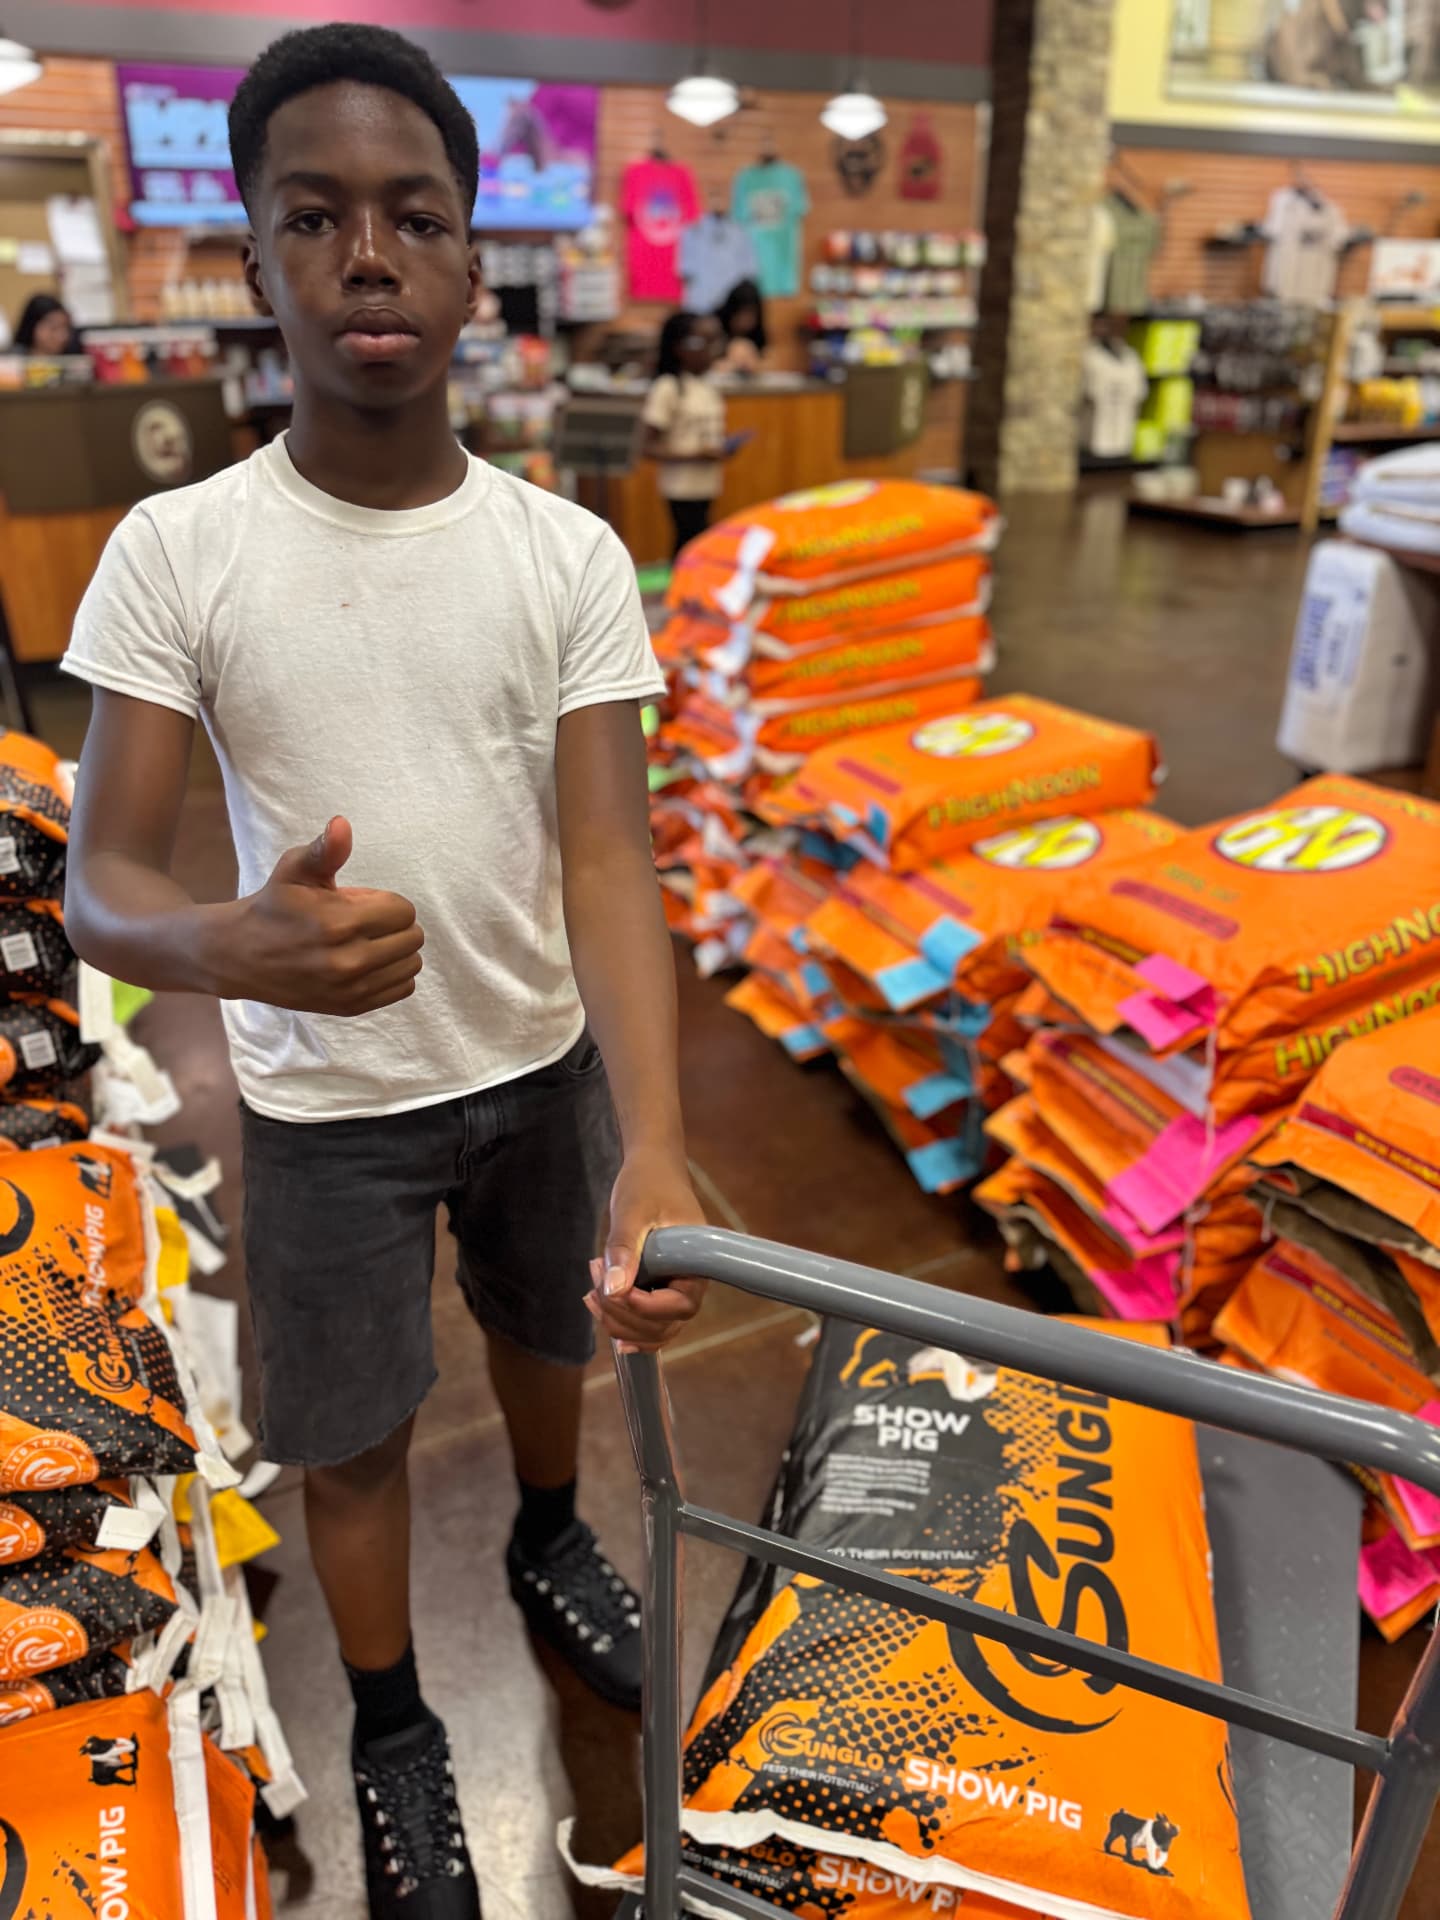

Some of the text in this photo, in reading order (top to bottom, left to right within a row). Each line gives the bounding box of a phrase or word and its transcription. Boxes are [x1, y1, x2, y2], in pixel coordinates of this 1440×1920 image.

[85, 1204, 106, 1241] PIG
[853, 1403, 971, 1436] SHOW
[877, 1424, 939, 1452] PIG
[848, 1547, 890, 1560] THEIR
[769, 1725, 885, 1772] SUNGLO
[763, 1763, 789, 1774] FEED
[789, 1766, 817, 1781] THEIR
[905, 1757, 1082, 1831] SHOW PIG
[98, 1805, 129, 1920] OW PIG
[702, 1855, 730, 1873] THEIR
[815, 1856, 928, 1904] SHOW
